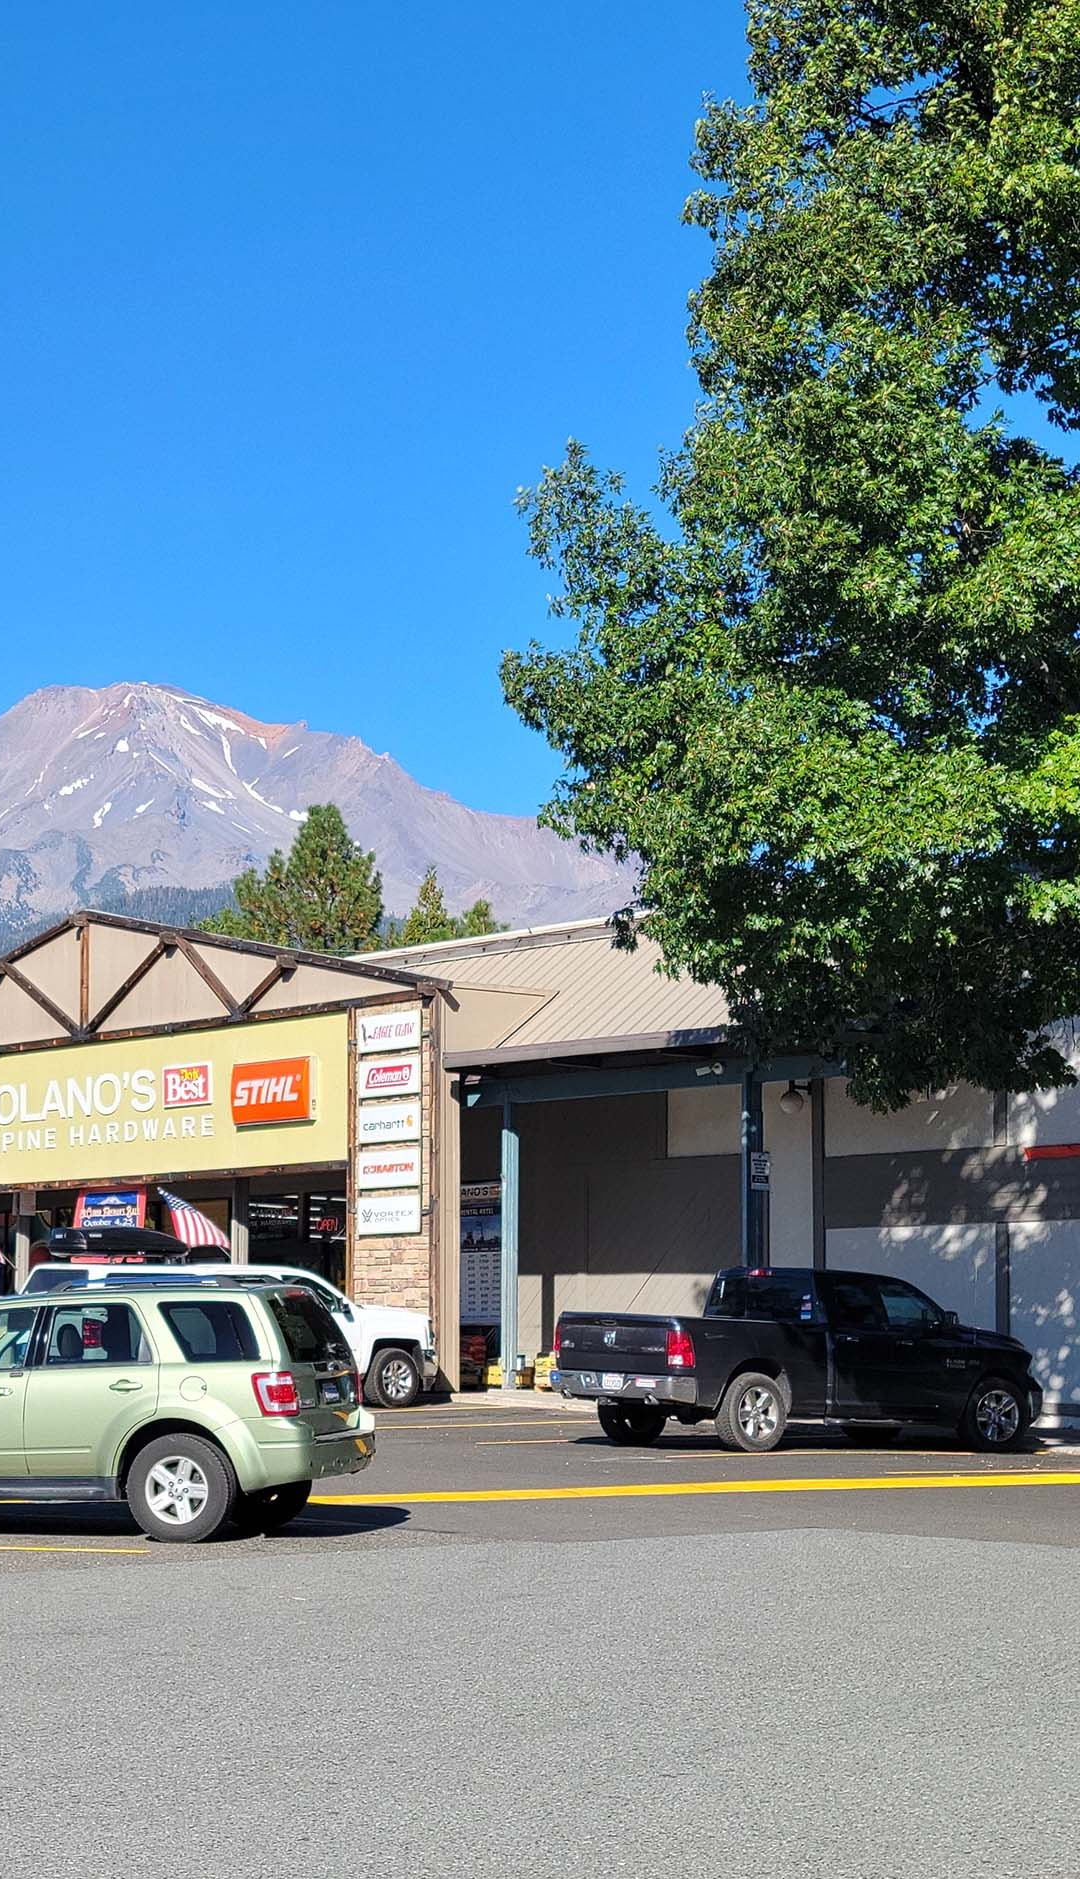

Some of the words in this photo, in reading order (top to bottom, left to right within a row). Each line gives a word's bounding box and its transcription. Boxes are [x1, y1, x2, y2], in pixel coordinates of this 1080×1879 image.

[368, 1068, 402, 1085] Coleman
[166, 1073, 206, 1102] Best
[233, 1075, 299, 1106] STIHL
[70, 1115, 215, 1148] HARDWARE
[362, 1119, 404, 1132] carhartt
[373, 1209, 414, 1218] VORTEX
[317, 1217, 338, 1231] OPEN
